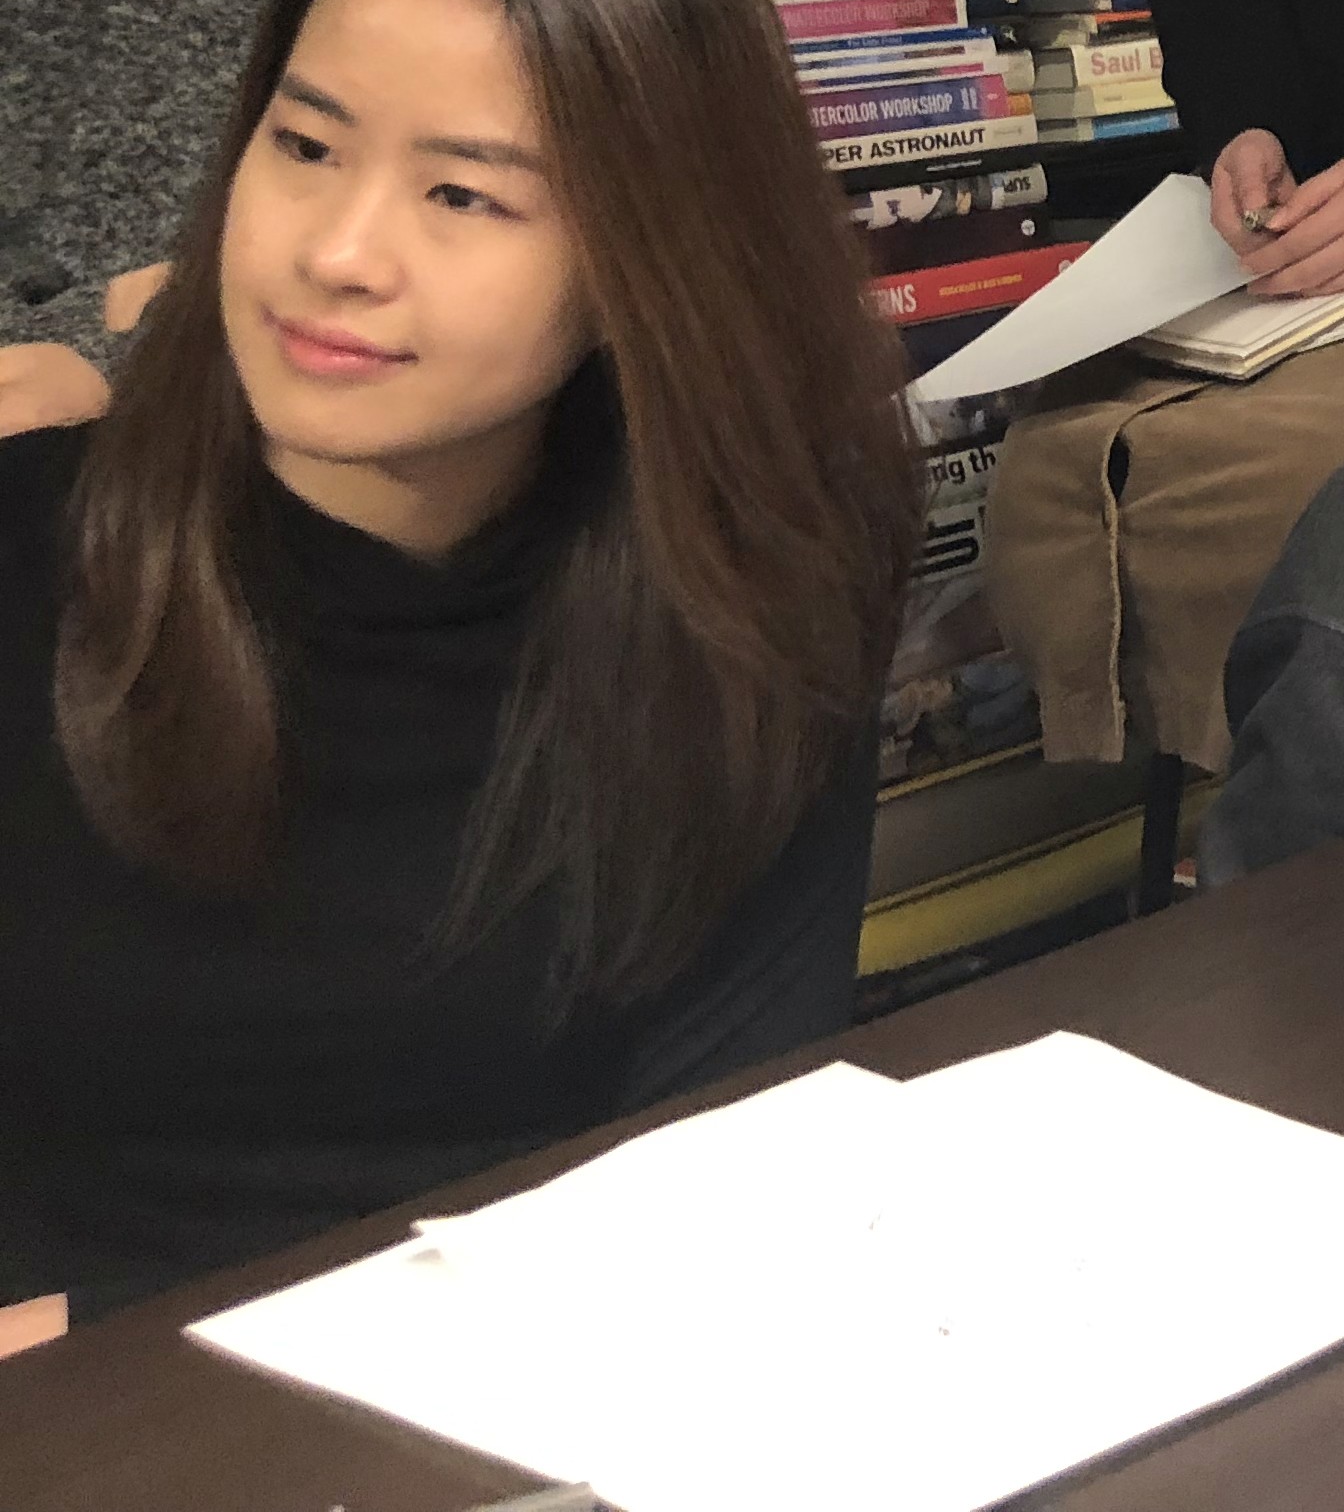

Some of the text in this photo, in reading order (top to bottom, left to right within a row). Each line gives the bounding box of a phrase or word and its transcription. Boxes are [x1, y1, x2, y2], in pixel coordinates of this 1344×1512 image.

[1091, 47, 1141, 76] Saul
[880, 91, 954, 122] WORKSHOP
[869, 126, 987, 160] ASTRONAUT
